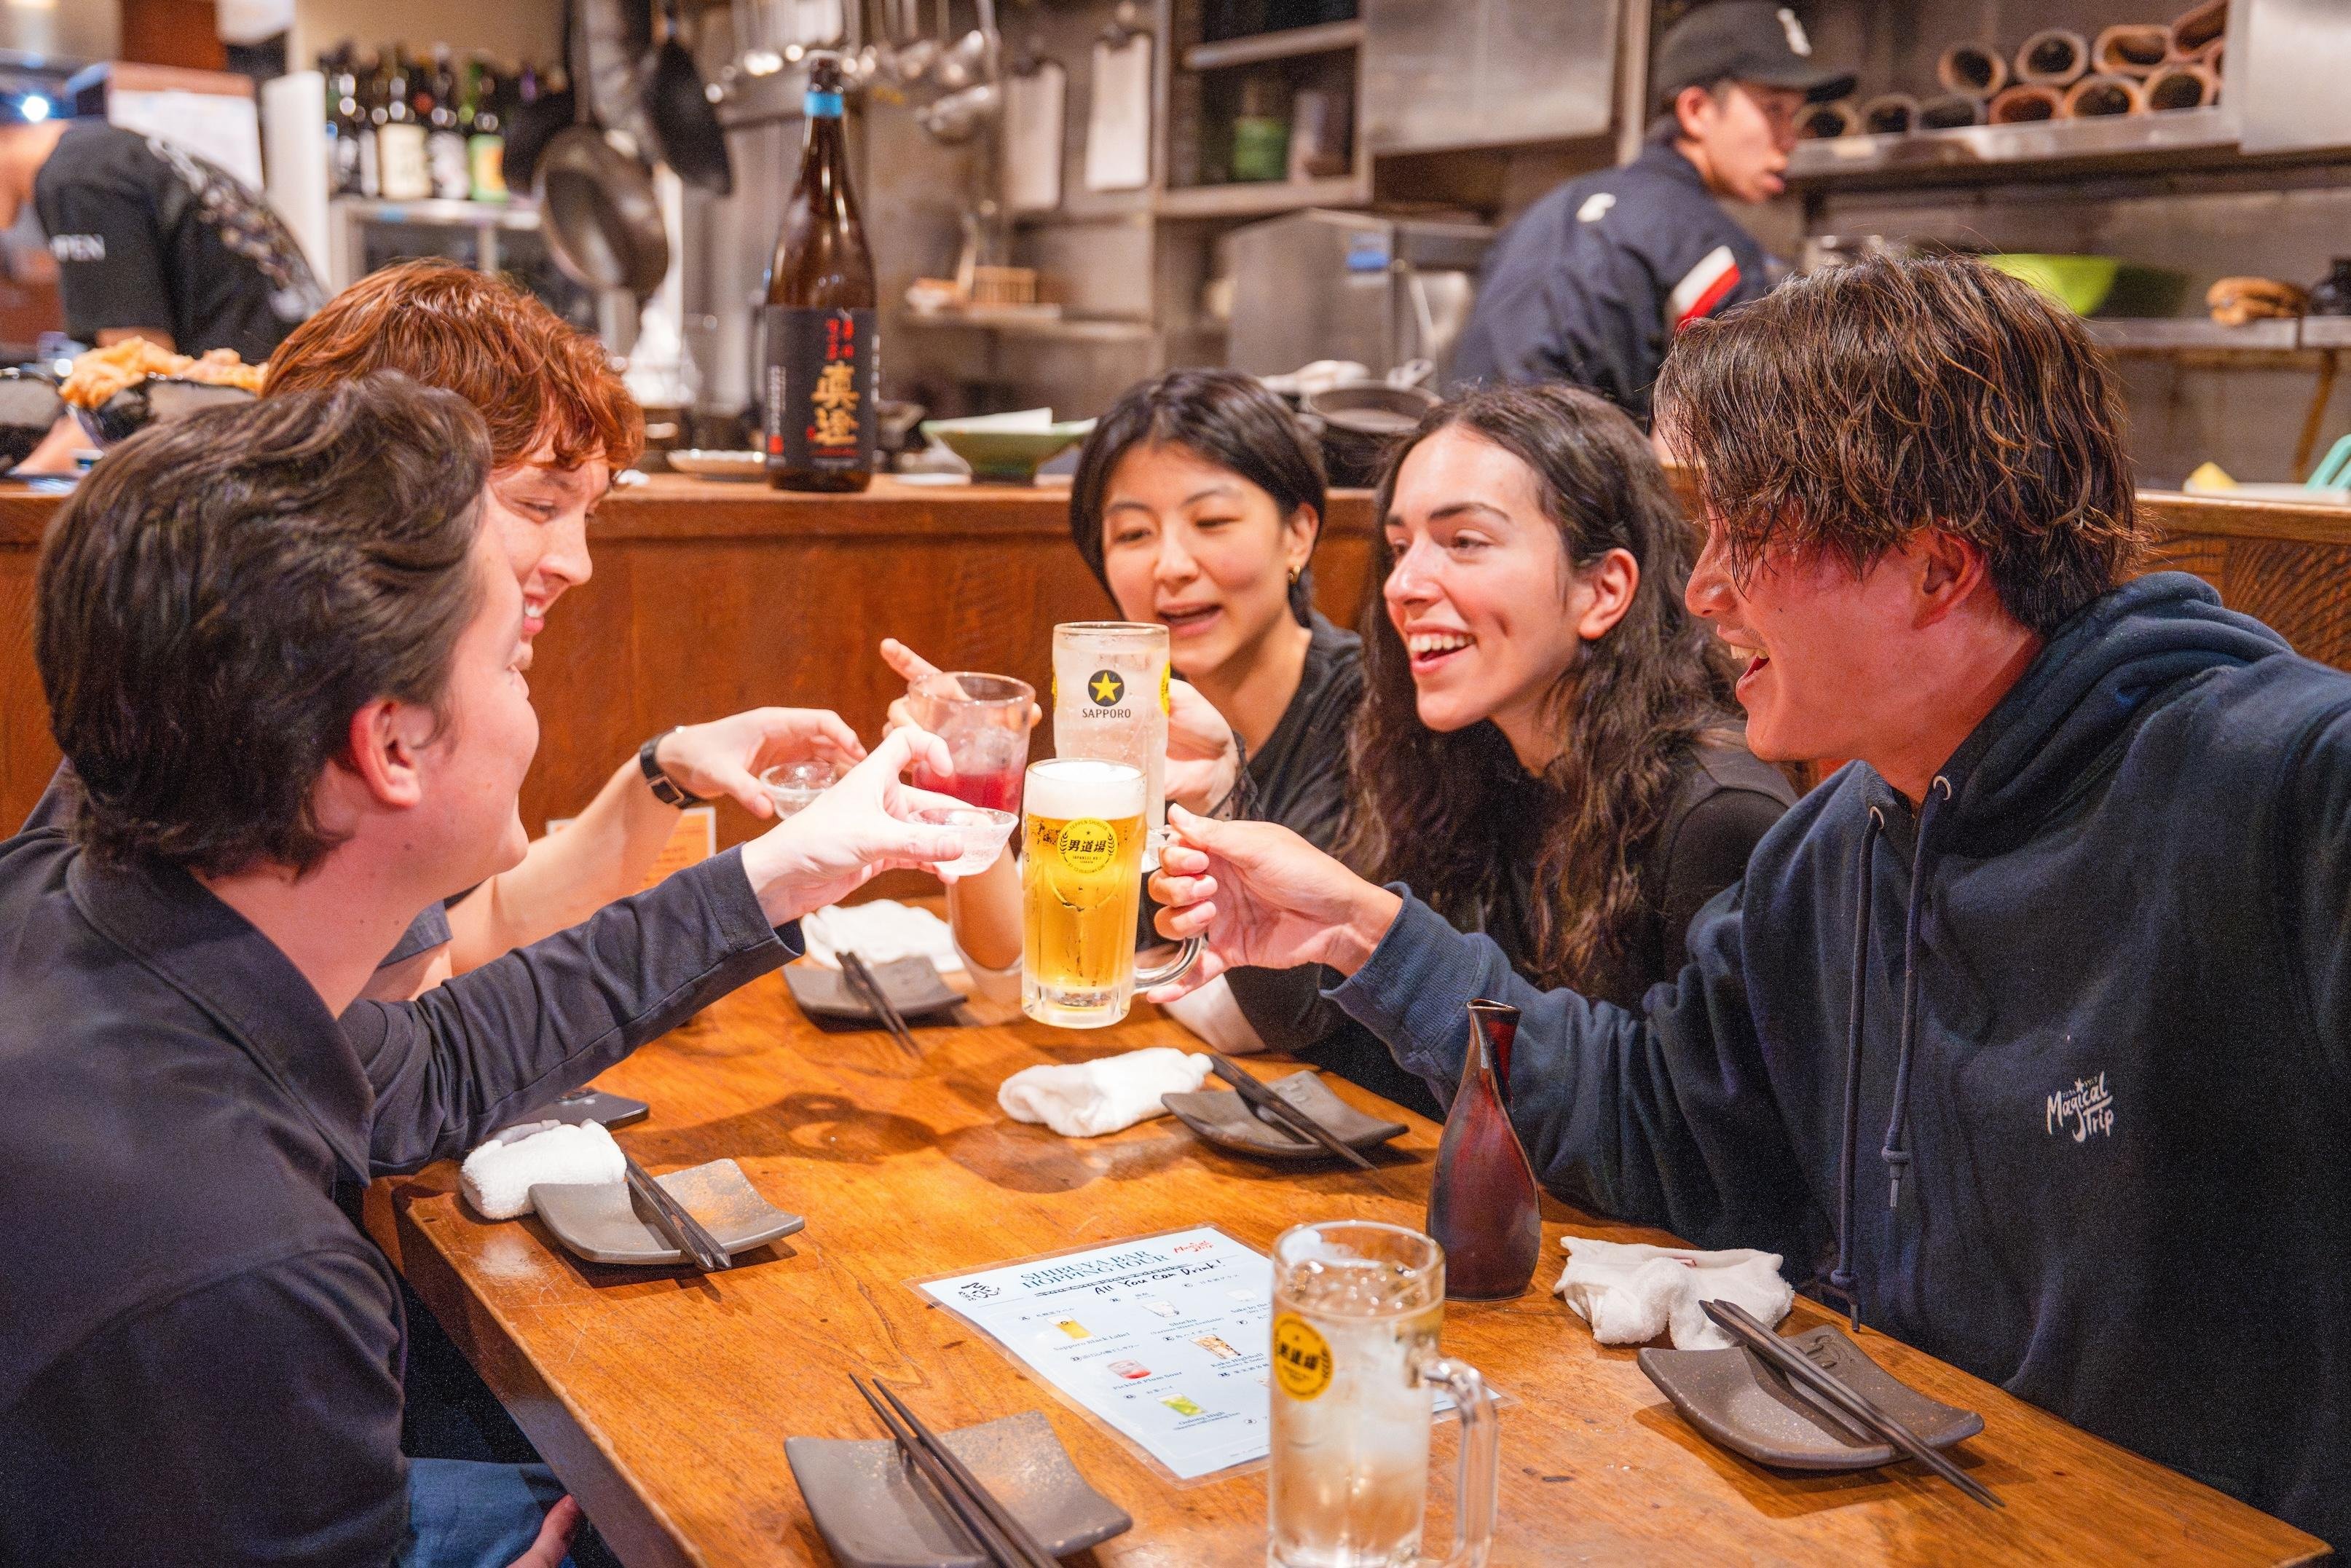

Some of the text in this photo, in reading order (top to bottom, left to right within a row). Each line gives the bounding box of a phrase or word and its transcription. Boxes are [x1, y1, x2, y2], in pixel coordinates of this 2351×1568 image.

[1082, 708, 1131, 718] SAPPORO
[1068, 839, 1107, 853] 男道場
[2047, 1071, 2108, 1142] Magical
[2082, 1095, 2114, 1138] Trip
[1020, 1250, 1152, 1281] SHIBUYA BAR
[1022, 1255, 1170, 1288] HOPPING TOUR
[1095, 1285, 1114, 1295] All
[1117, 1280, 1148, 1288] You
[1180, 1258, 1226, 1275] Drink!
[1168, 1318, 1197, 1327] Shochu
[1053, 1331, 1130, 1351] Sapporo Black Label
[1113, 1380, 1142, 1391] Pickled
